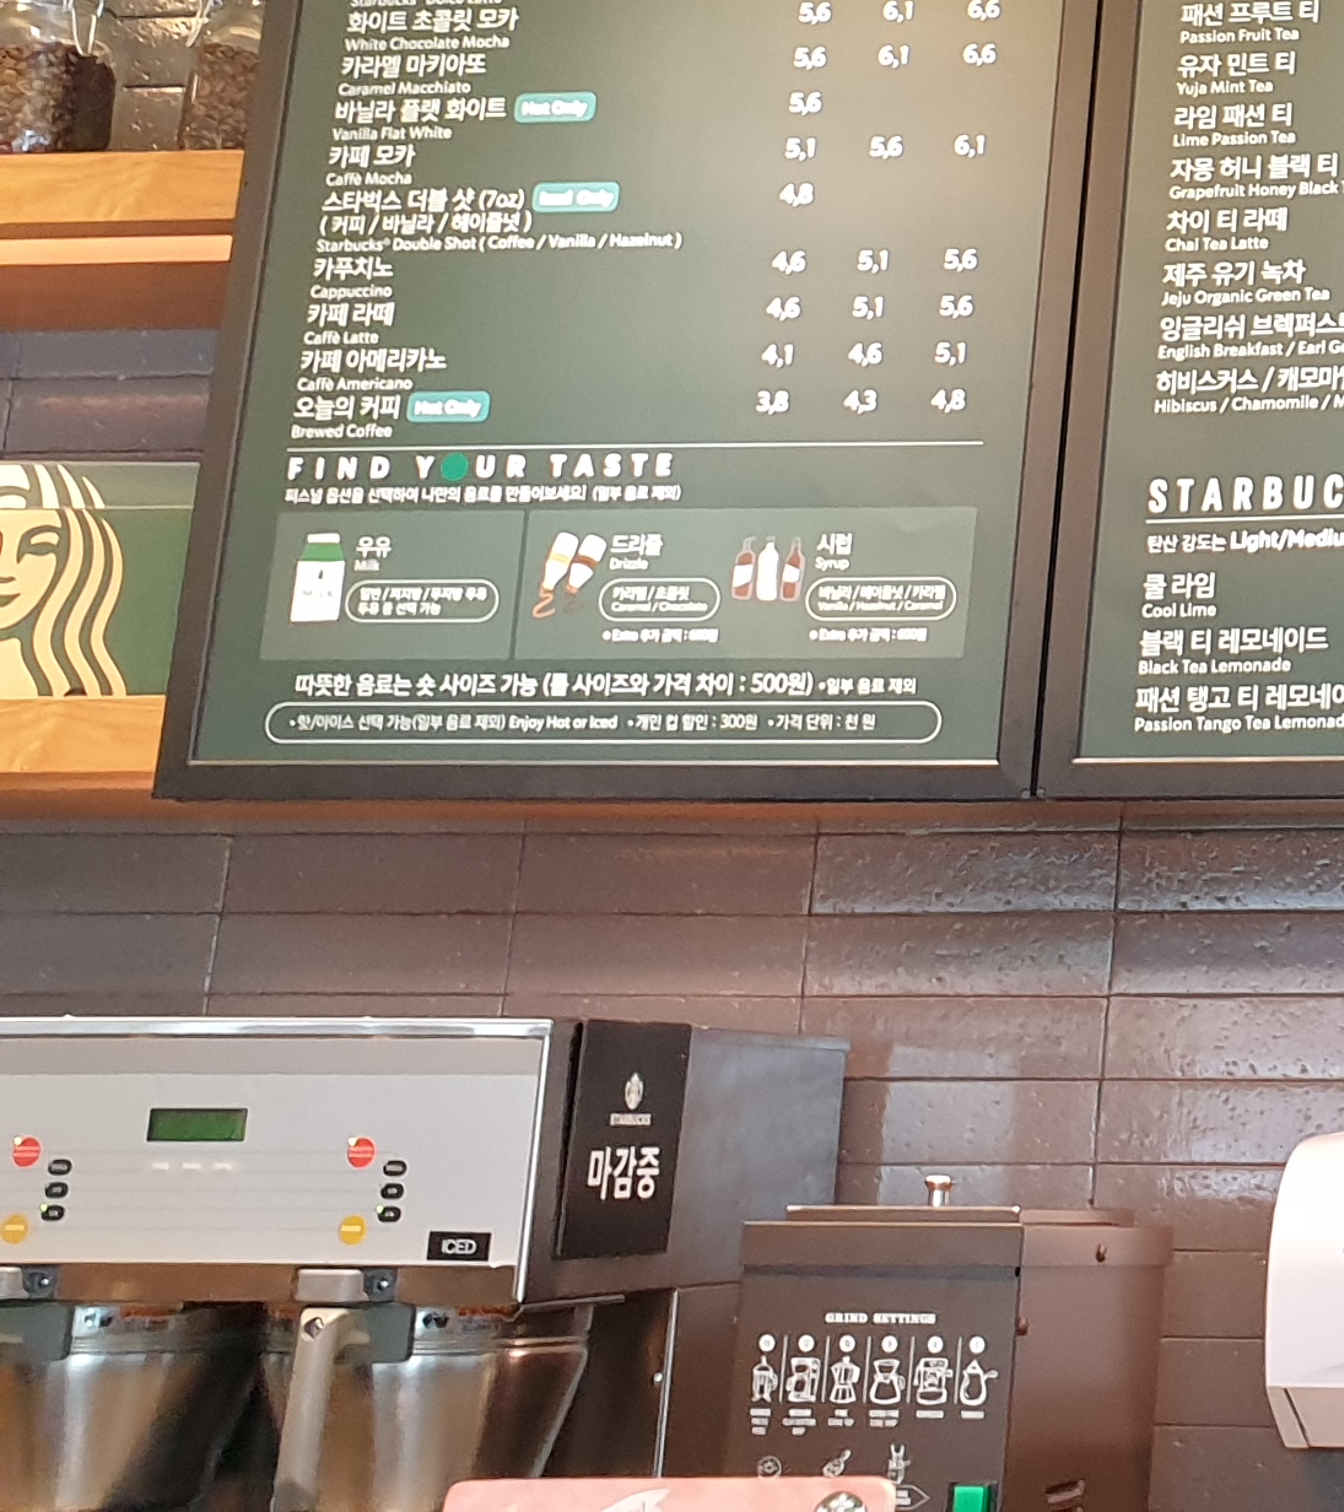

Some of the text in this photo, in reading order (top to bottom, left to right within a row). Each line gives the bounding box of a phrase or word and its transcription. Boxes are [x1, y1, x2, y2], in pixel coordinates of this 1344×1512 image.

[344, 34, 510, 52] White Chocolate Mocha
[1177, 50, 1296, 79] 유자 민트 티
[1176, 79, 1274, 98] Yuja Mint Tea
[313, 255, 394, 282] 카푸치노
[771, 248, 978, 275] 4,6 5,1 5,6
[1162, 258, 1307, 288] 제주 유기 녹차
[300, 346, 448, 374] 카페 아메리카노
[293, 394, 356, 421] 오늘의
[359, 394, 401, 420] 커피
[755, 388, 966, 415] 3,8 4,3 4,8
[291, 422, 393, 439] Brewed Coffee
[288, 453, 672, 479] FIND TASTE
[355, 535, 392, 558] 우유
[816, 532, 852, 556] 시럽
[1141, 602, 1217, 619] Cool Lime
[295, 671, 814, 697] 따뜻한 음료는 숏 사이즈 가능 사이즈와 가격 차이 500원)
[1135, 686, 1181, 714] 패션
[1186, 685, 1232, 713] 탱고
[1237, 684, 1259, 712] 티
[1134, 716, 1193, 732] Passion
[1196, 715, 1242, 734] Tango
[1244, 714, 1271, 731] Tea
[587, 1146, 660, 1200] 마감중
[442, 1239, 477, 1254] ICED
